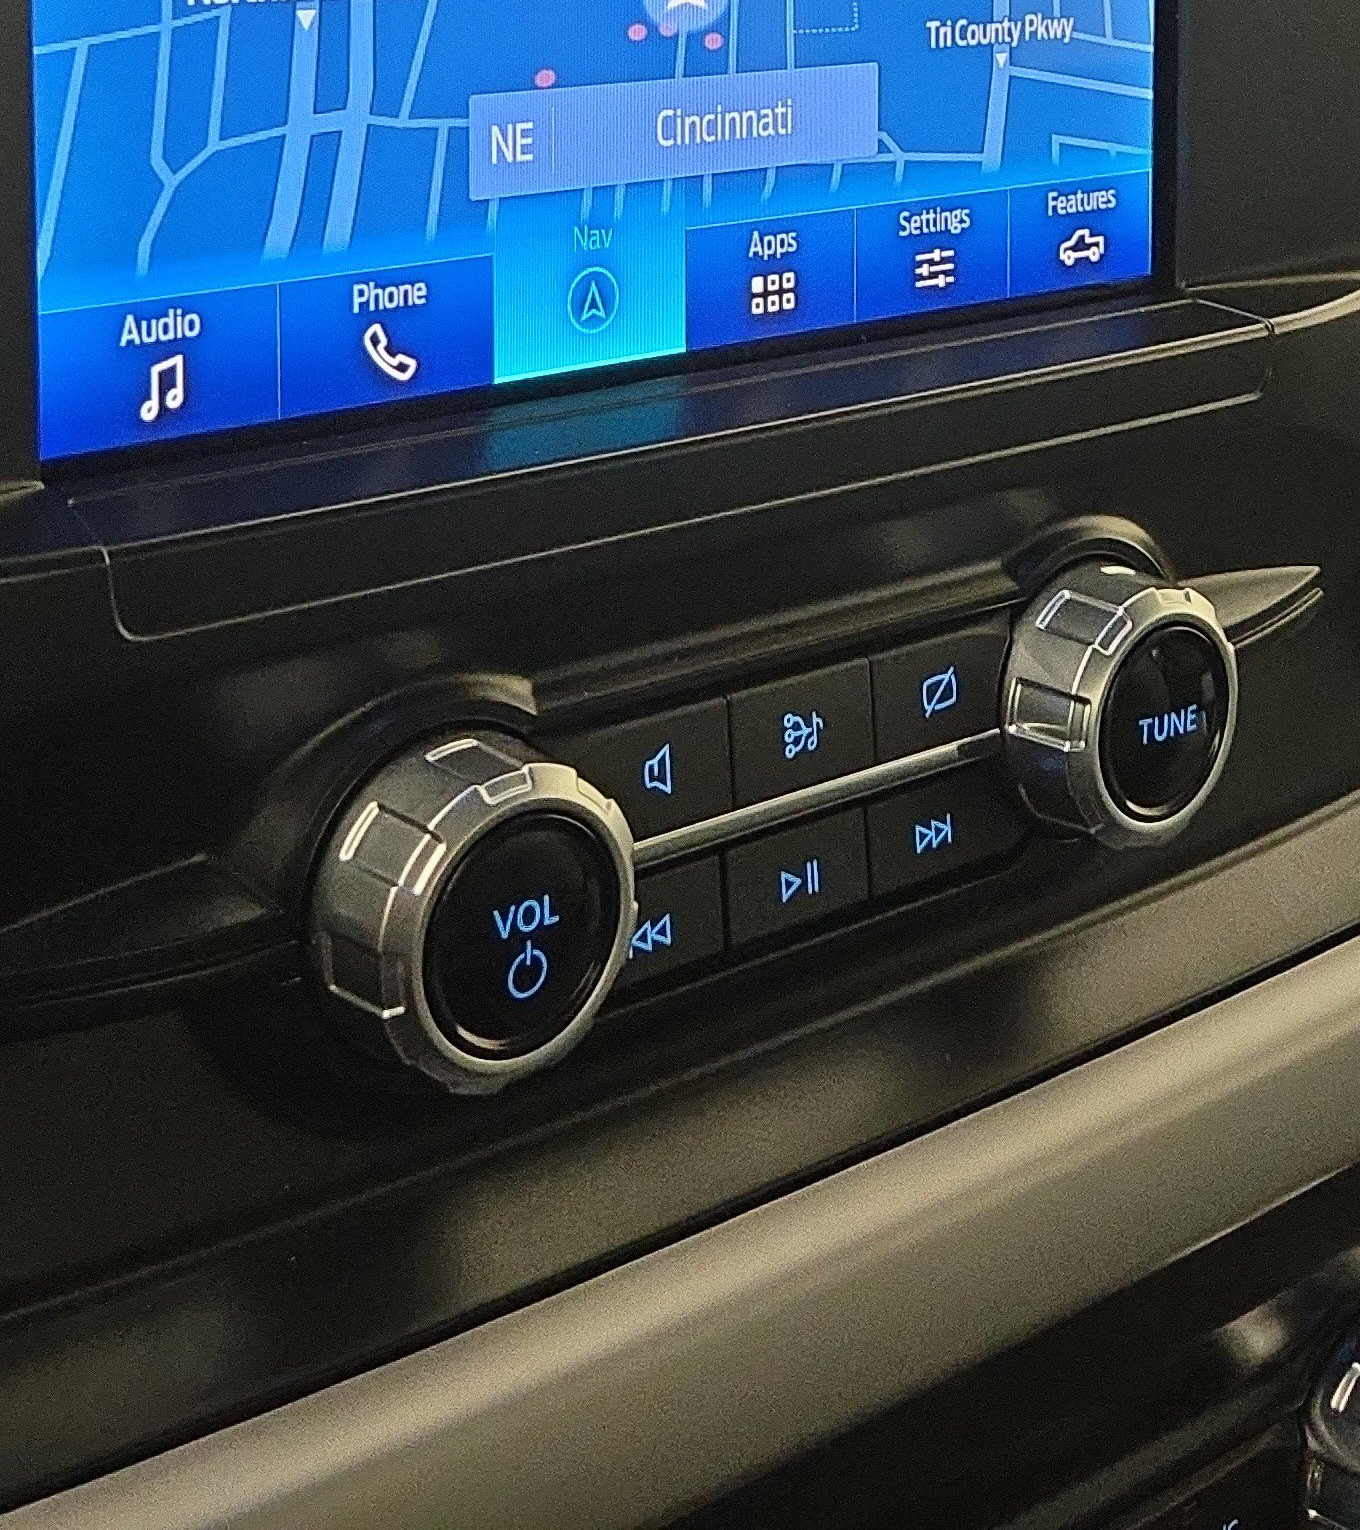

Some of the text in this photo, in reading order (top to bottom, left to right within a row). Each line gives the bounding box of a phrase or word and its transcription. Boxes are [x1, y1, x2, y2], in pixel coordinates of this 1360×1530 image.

[926, 11, 1074, 49] Tri County Pkwy
[656, 98, 794, 148] Cincinnati
[490, 121, 535, 165] NE
[1047, 186, 1117, 217] Features
[573, 223, 614, 252] Nav
[898, 206, 971, 238] Settings
[748, 228, 798, 260] Apps
[352, 279, 428, 314] Phone
[119, 308, 201, 347] Audio
[1138, 704, 1198, 747] TUNE
[493, 894, 560, 939] VOL
